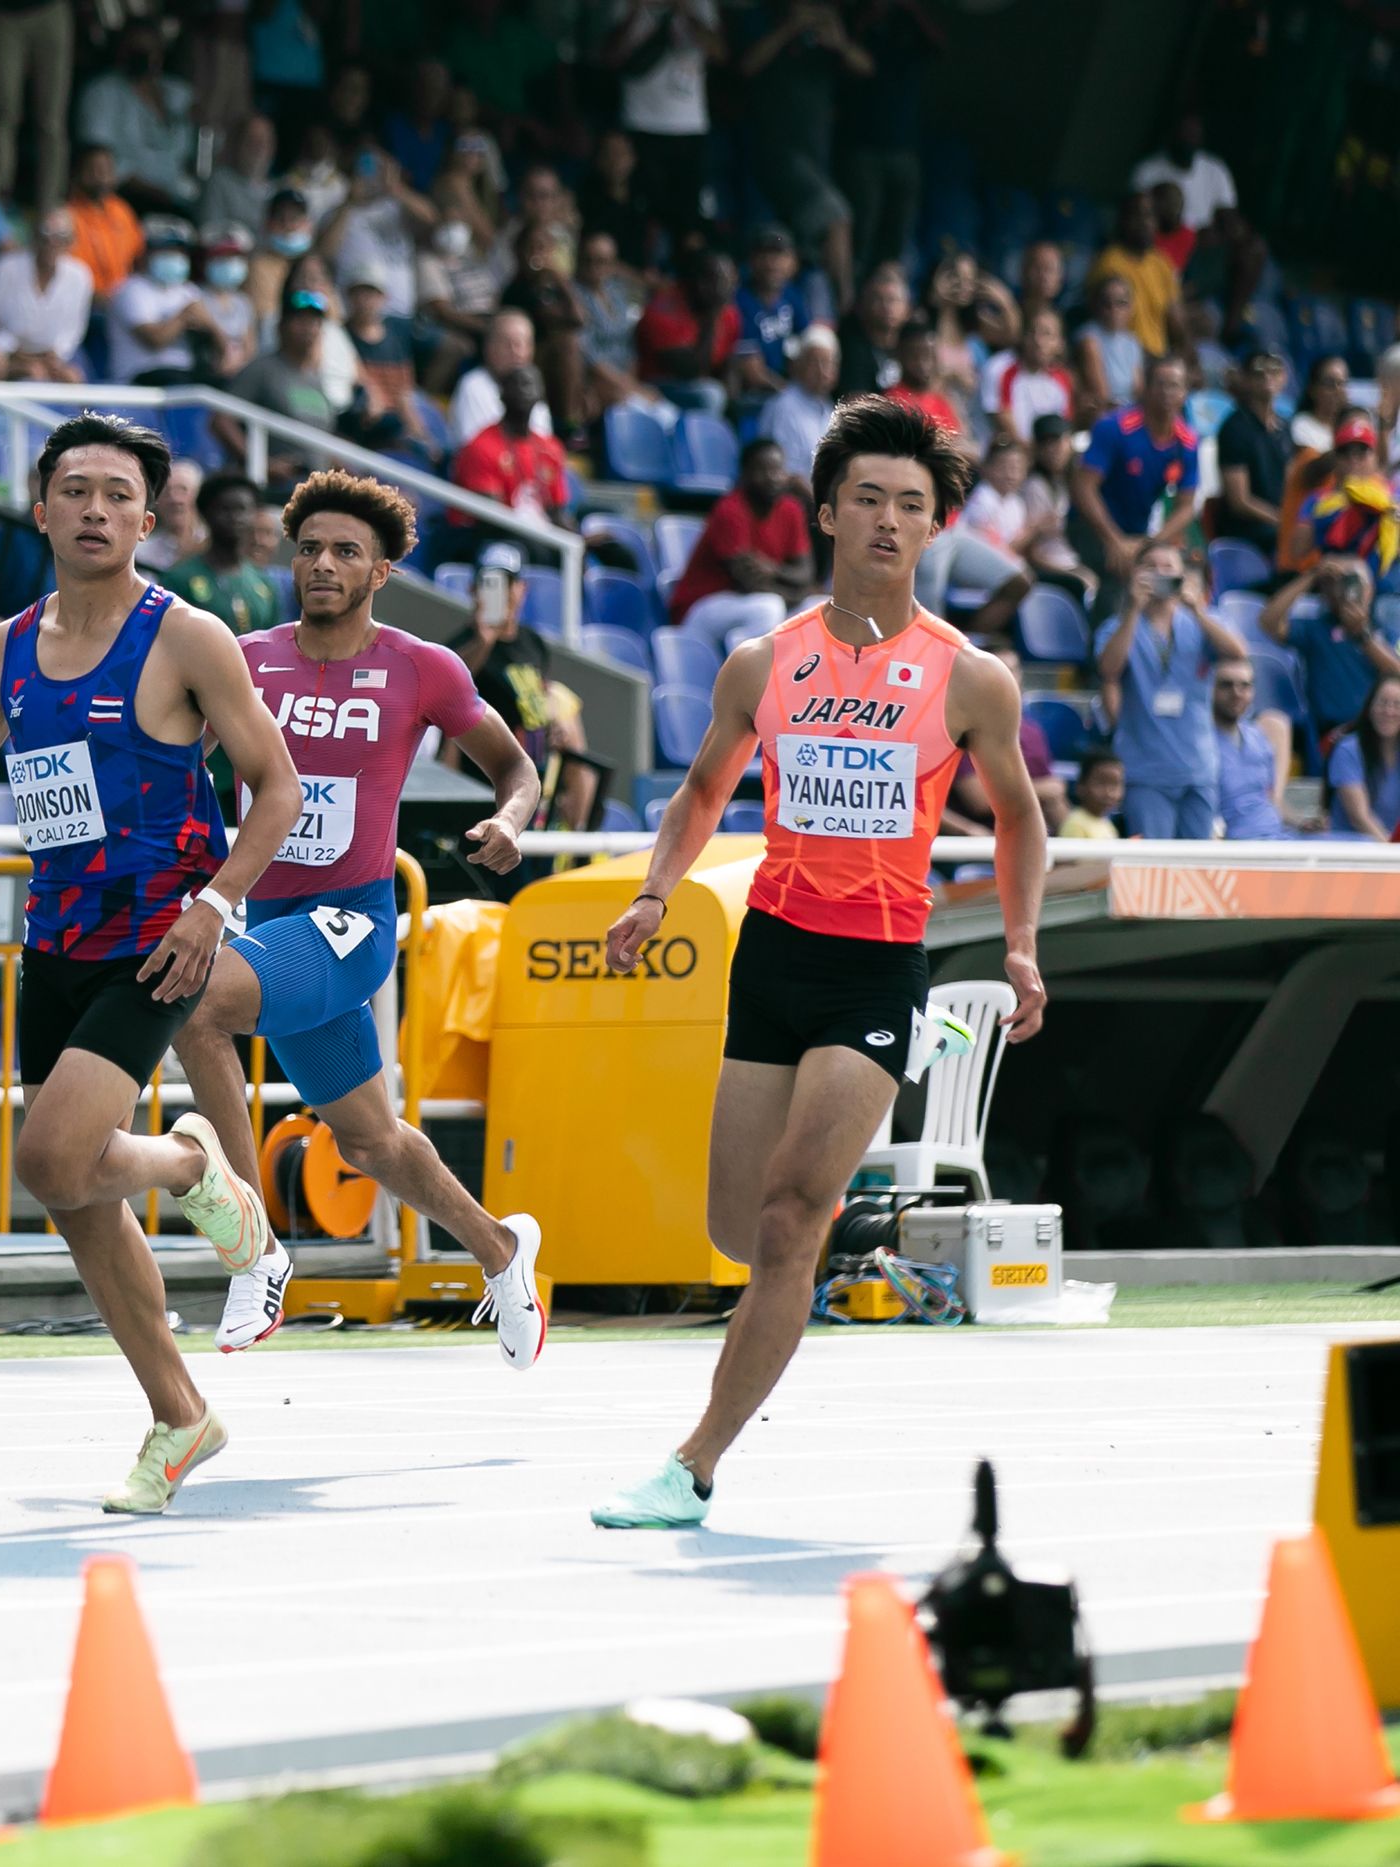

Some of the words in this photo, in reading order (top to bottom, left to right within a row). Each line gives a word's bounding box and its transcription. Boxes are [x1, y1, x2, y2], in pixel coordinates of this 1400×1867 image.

[790, 697, 906, 731] JAPAN
[25, 751, 74, 781] TDK
[818, 744, 896, 772] TDK
[16, 783, 93, 824] OONSON
[786, 773, 907, 810] YANAGITA
[37, 825, 65, 844] CALI
[66, 821, 90, 839] 22
[823, 816, 867, 834] CALI
[871, 819, 898, 834] 22
[314, 847, 336, 861] 22
[326, 908, 356, 937] 5
[527, 937, 698, 981] SEKO
[991, 1265, 1048, 1286] SEIKO
